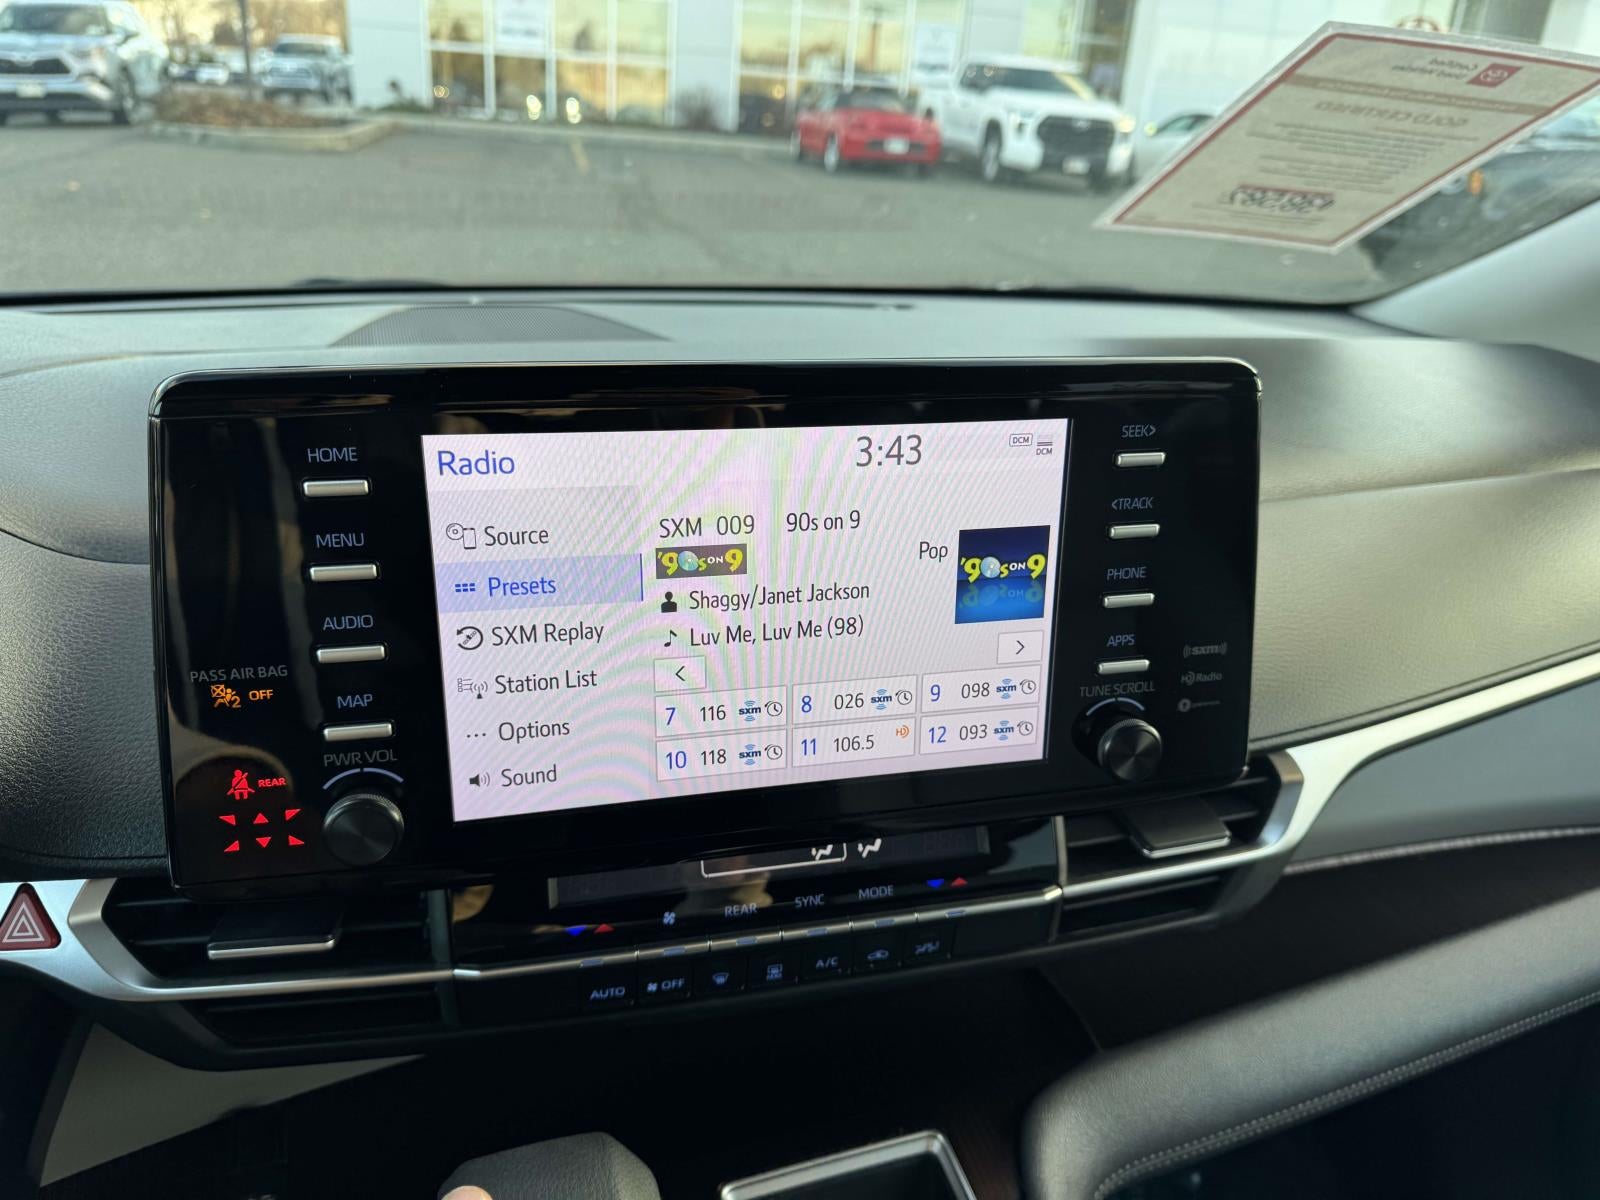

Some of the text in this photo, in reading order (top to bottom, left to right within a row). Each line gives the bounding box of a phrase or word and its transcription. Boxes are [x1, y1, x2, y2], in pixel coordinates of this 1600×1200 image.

[1012, 436, 1030, 444] DCM
[307, 447, 358, 463] HOME
[856, 434, 922, 467] 3:43
[1036, 448, 1053, 456] DCM
[437, 449, 515, 476] Radio
[659, 514, 755, 538] SXM 009
[786, 509, 861, 532] 90s on 9
[315, 533, 365, 548] MENU
[484, 525, 549, 546] Source
[707, 555, 724, 564] ON
[725, 548, 744, 572] 9
[919, 541, 948, 562] Pop
[1009, 562, 1026, 571] ON
[1027, 553, 1046, 579] 9
[1106, 566, 1147, 580] PHONE
[487, 576, 557, 597] Presets
[689, 582, 870, 611] Shaggy/Janet Jackson
[323, 614, 374, 630] AUDIO
[690, 614, 864, 646] Luv Me, Luv Me (98)
[491, 621, 604, 646] SXM Replay
[1107, 634, 1135, 647] APPS
[190, 664, 288, 682] PASS AIR BAG
[495, 669, 598, 694] Station List
[1196, 672, 1222, 682] Radio
[249, 689, 274, 701] OFF
[930, 682, 1017, 702] 9 098 sxm
[1080, 681, 1155, 697] TUNE SCROLL
[337, 694, 373, 709] MAP
[801, 693, 892, 713] 8 026 sxm
[665, 704, 761, 726] 7 116 sxm
[499, 720, 570, 744] Options
[928, 724, 1014, 744] 12 093 sxm
[801, 738, 817, 756] 11
[833, 734, 875, 752] 106.5
[323, 749, 398, 767] PWR VOL
[666, 749, 761, 770] 10 118 sxm
[258, 777, 287, 788] REAR
[501, 764, 557, 787] Sound
[795, 894, 825, 908] SYNC
[858, 885, 894, 899] MODE
[724, 903, 757, 917] REAR
[816, 956, 838, 970] A/C
[590, 987, 625, 1000] AUTO
[661, 978, 685, 990] OFF
